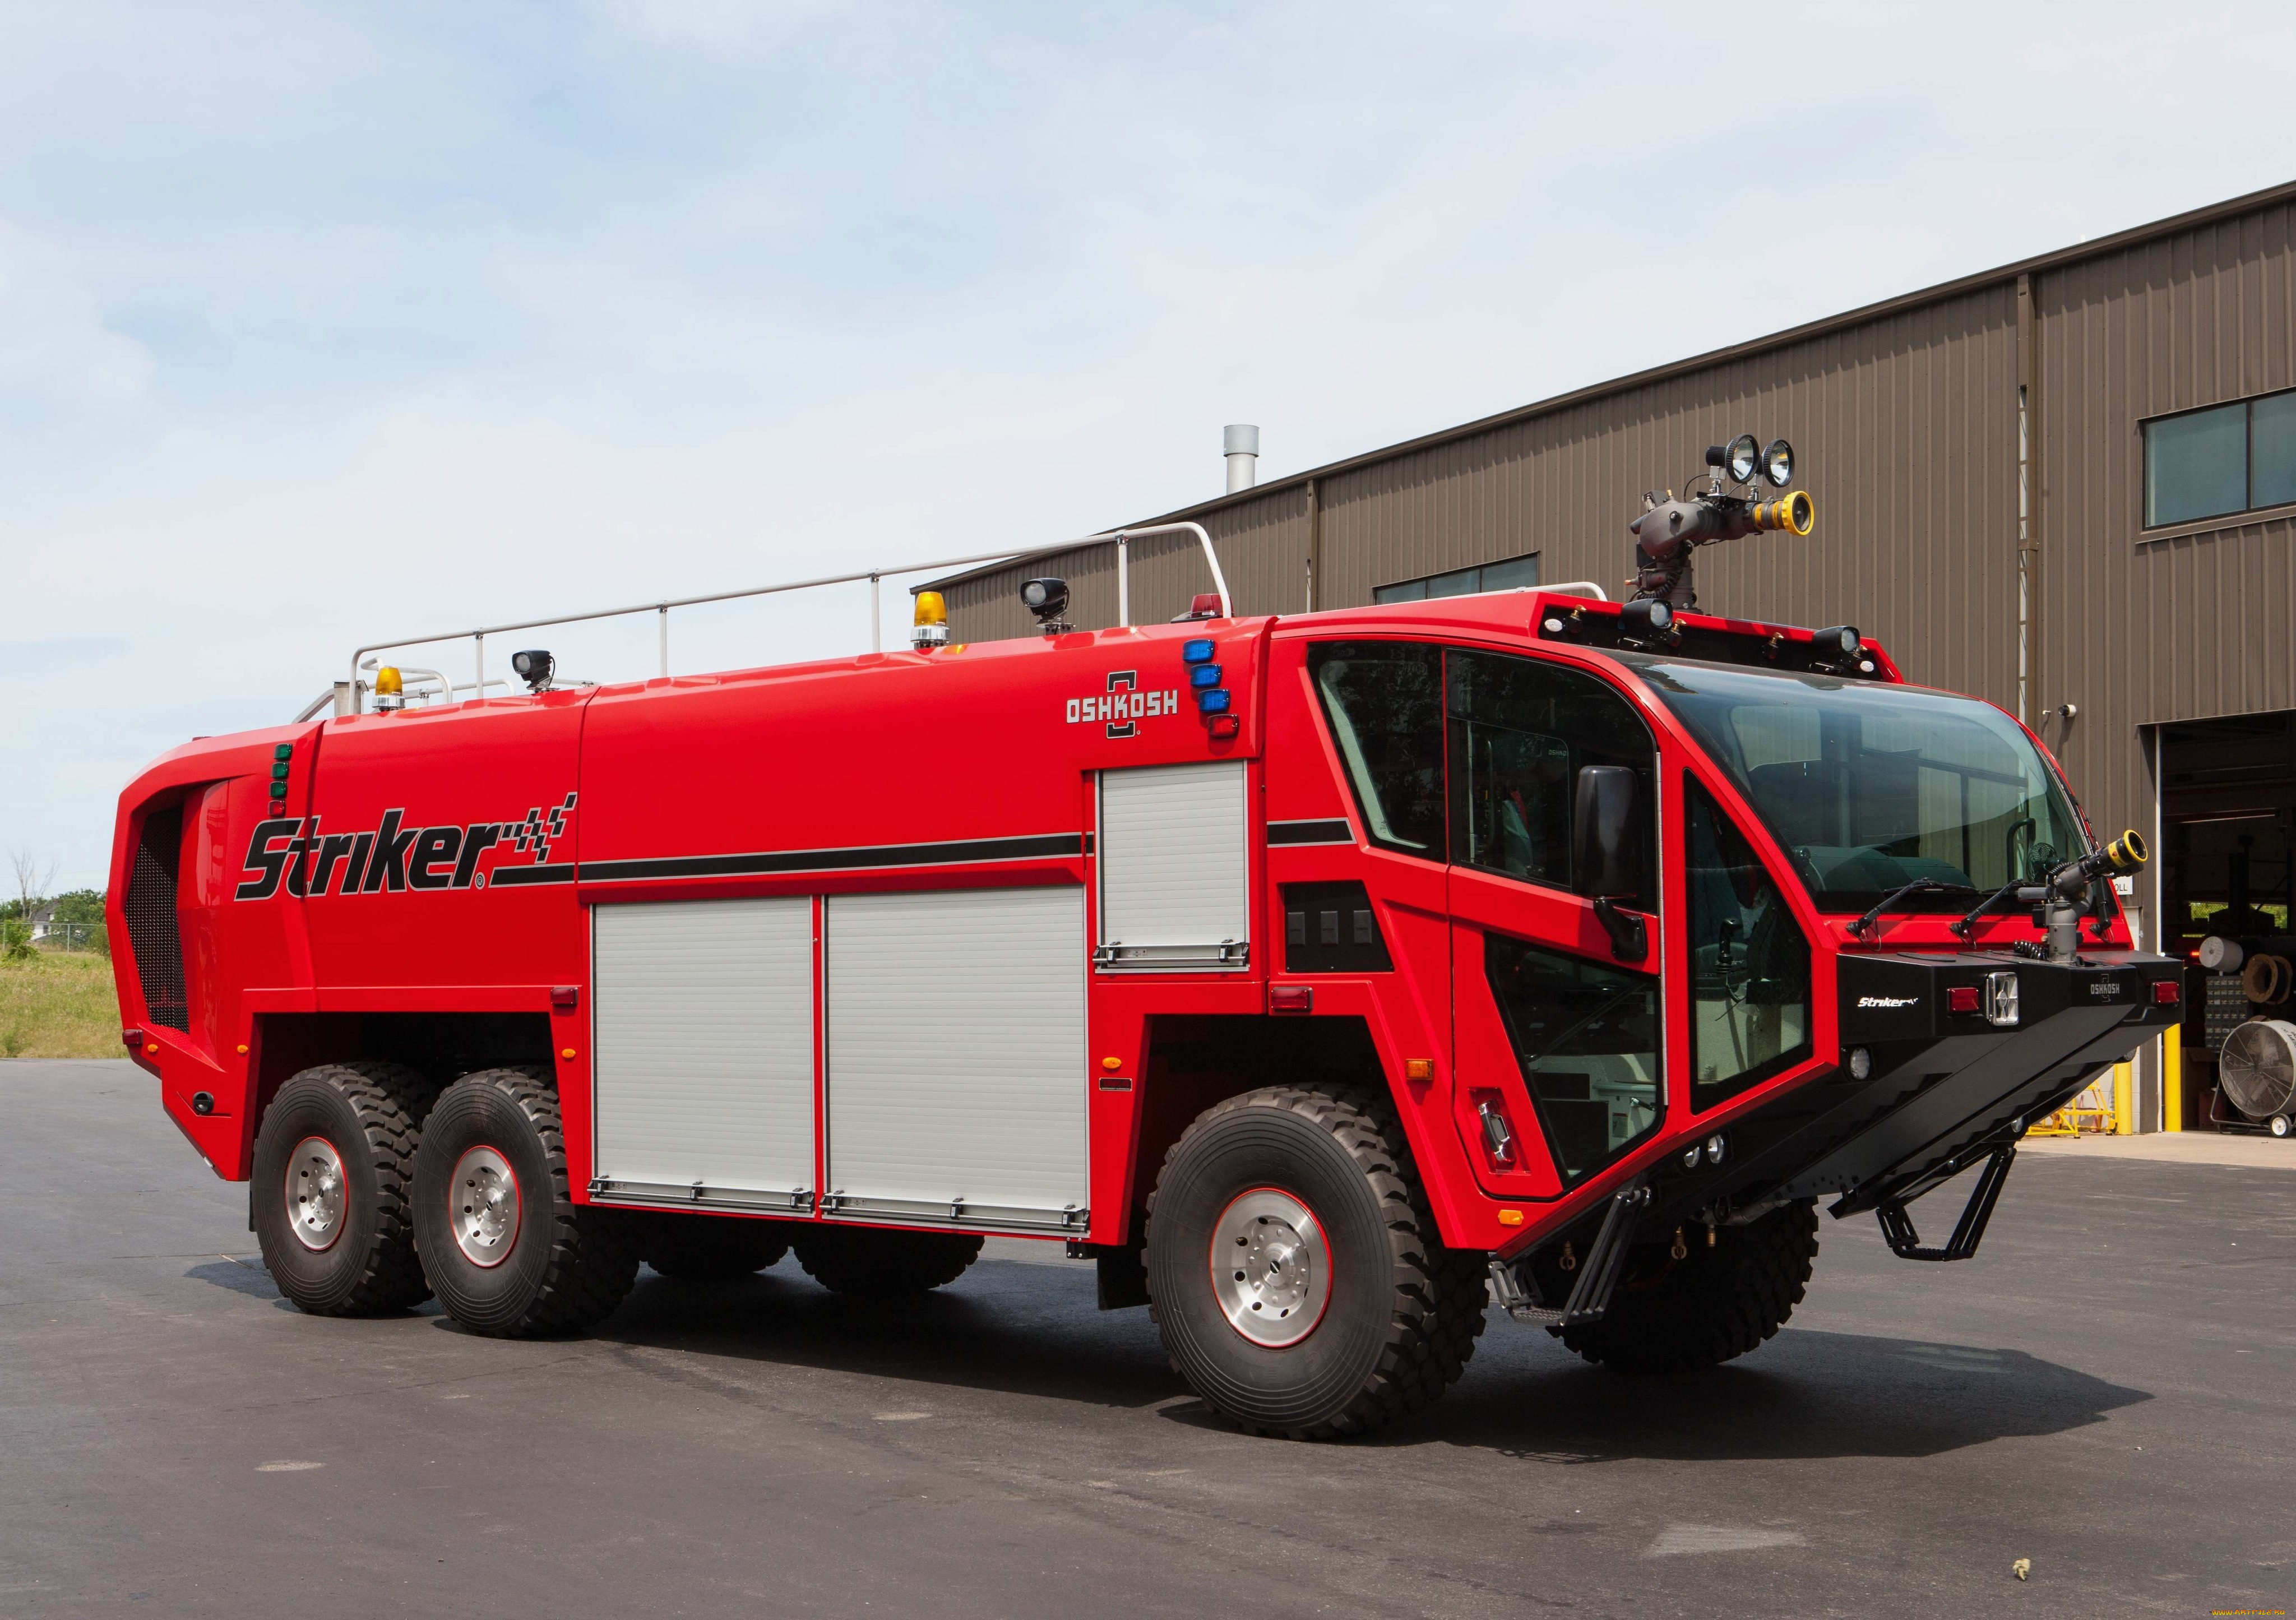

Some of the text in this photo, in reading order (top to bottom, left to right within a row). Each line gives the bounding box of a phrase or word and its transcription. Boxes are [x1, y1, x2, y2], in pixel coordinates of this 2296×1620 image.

[1066, 689, 1178, 723] OSHKOSH
[2091, 983, 2119, 994] OSHKOSH
[1857, 997, 1906, 1007] Striker
